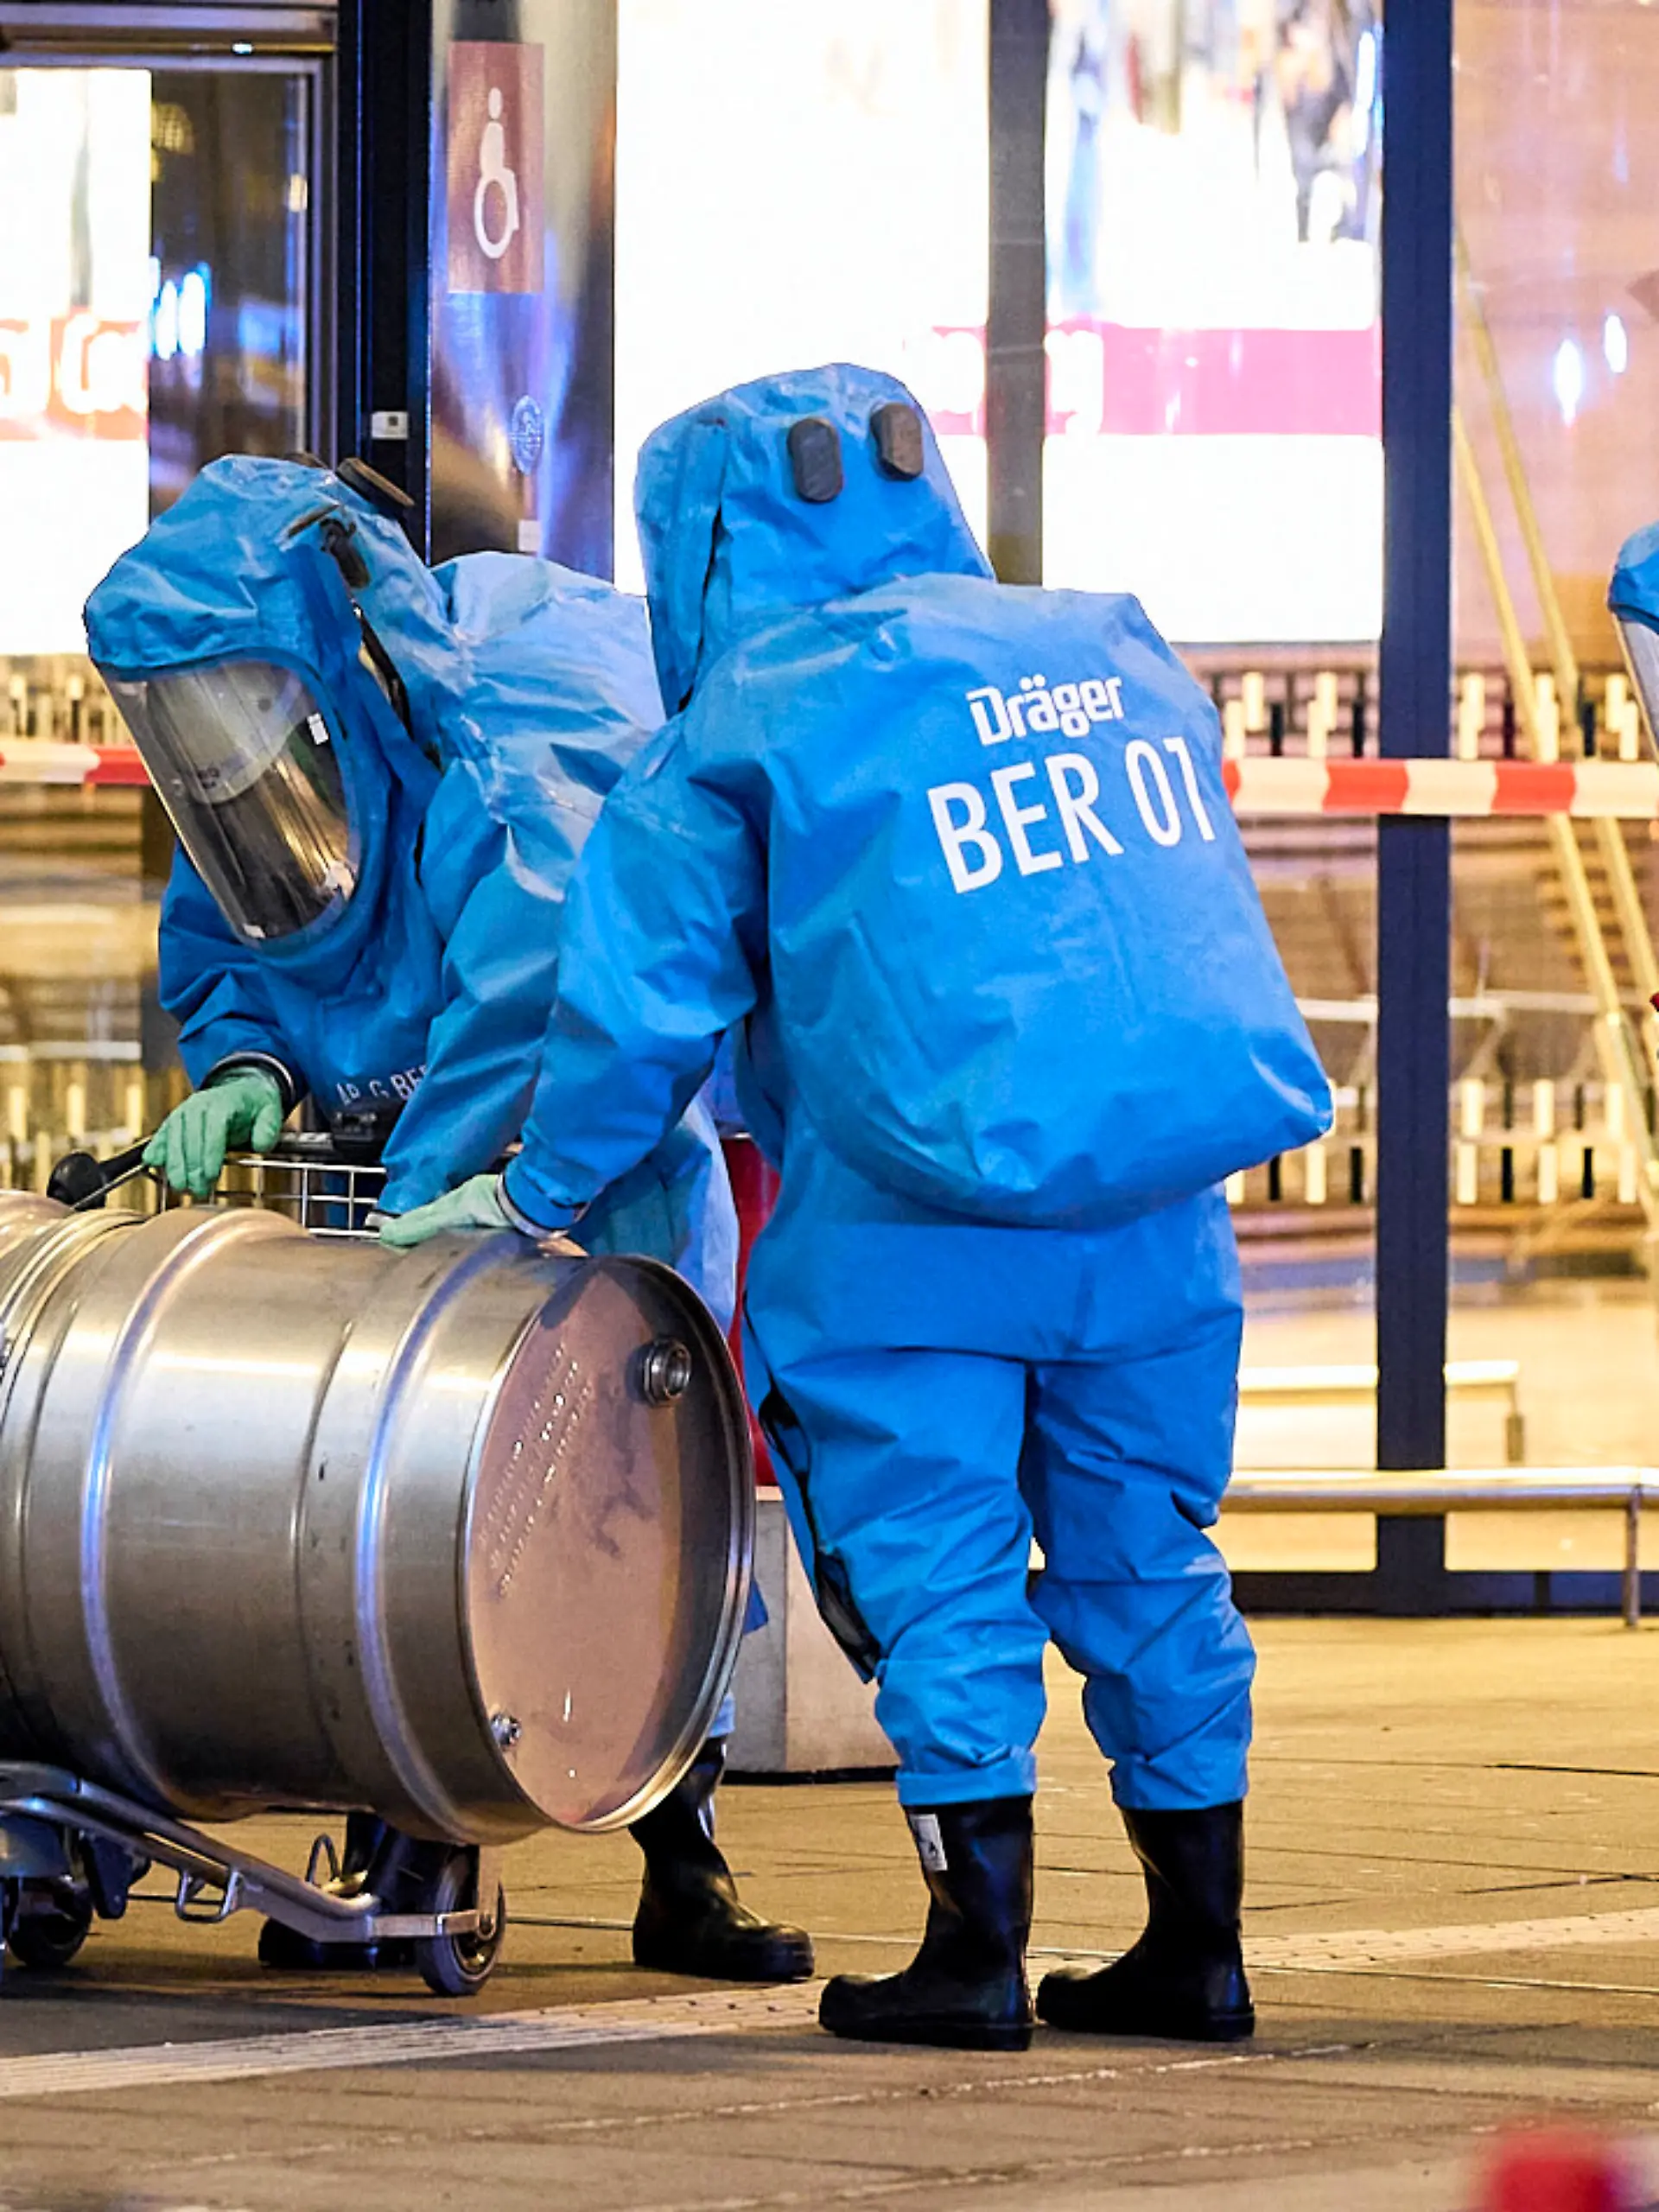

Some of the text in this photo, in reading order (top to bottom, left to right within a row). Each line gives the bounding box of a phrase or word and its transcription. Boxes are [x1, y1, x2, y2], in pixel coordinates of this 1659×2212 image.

[965, 675, 1122, 746] Dräger
[927, 736, 1216, 894] BER 01
